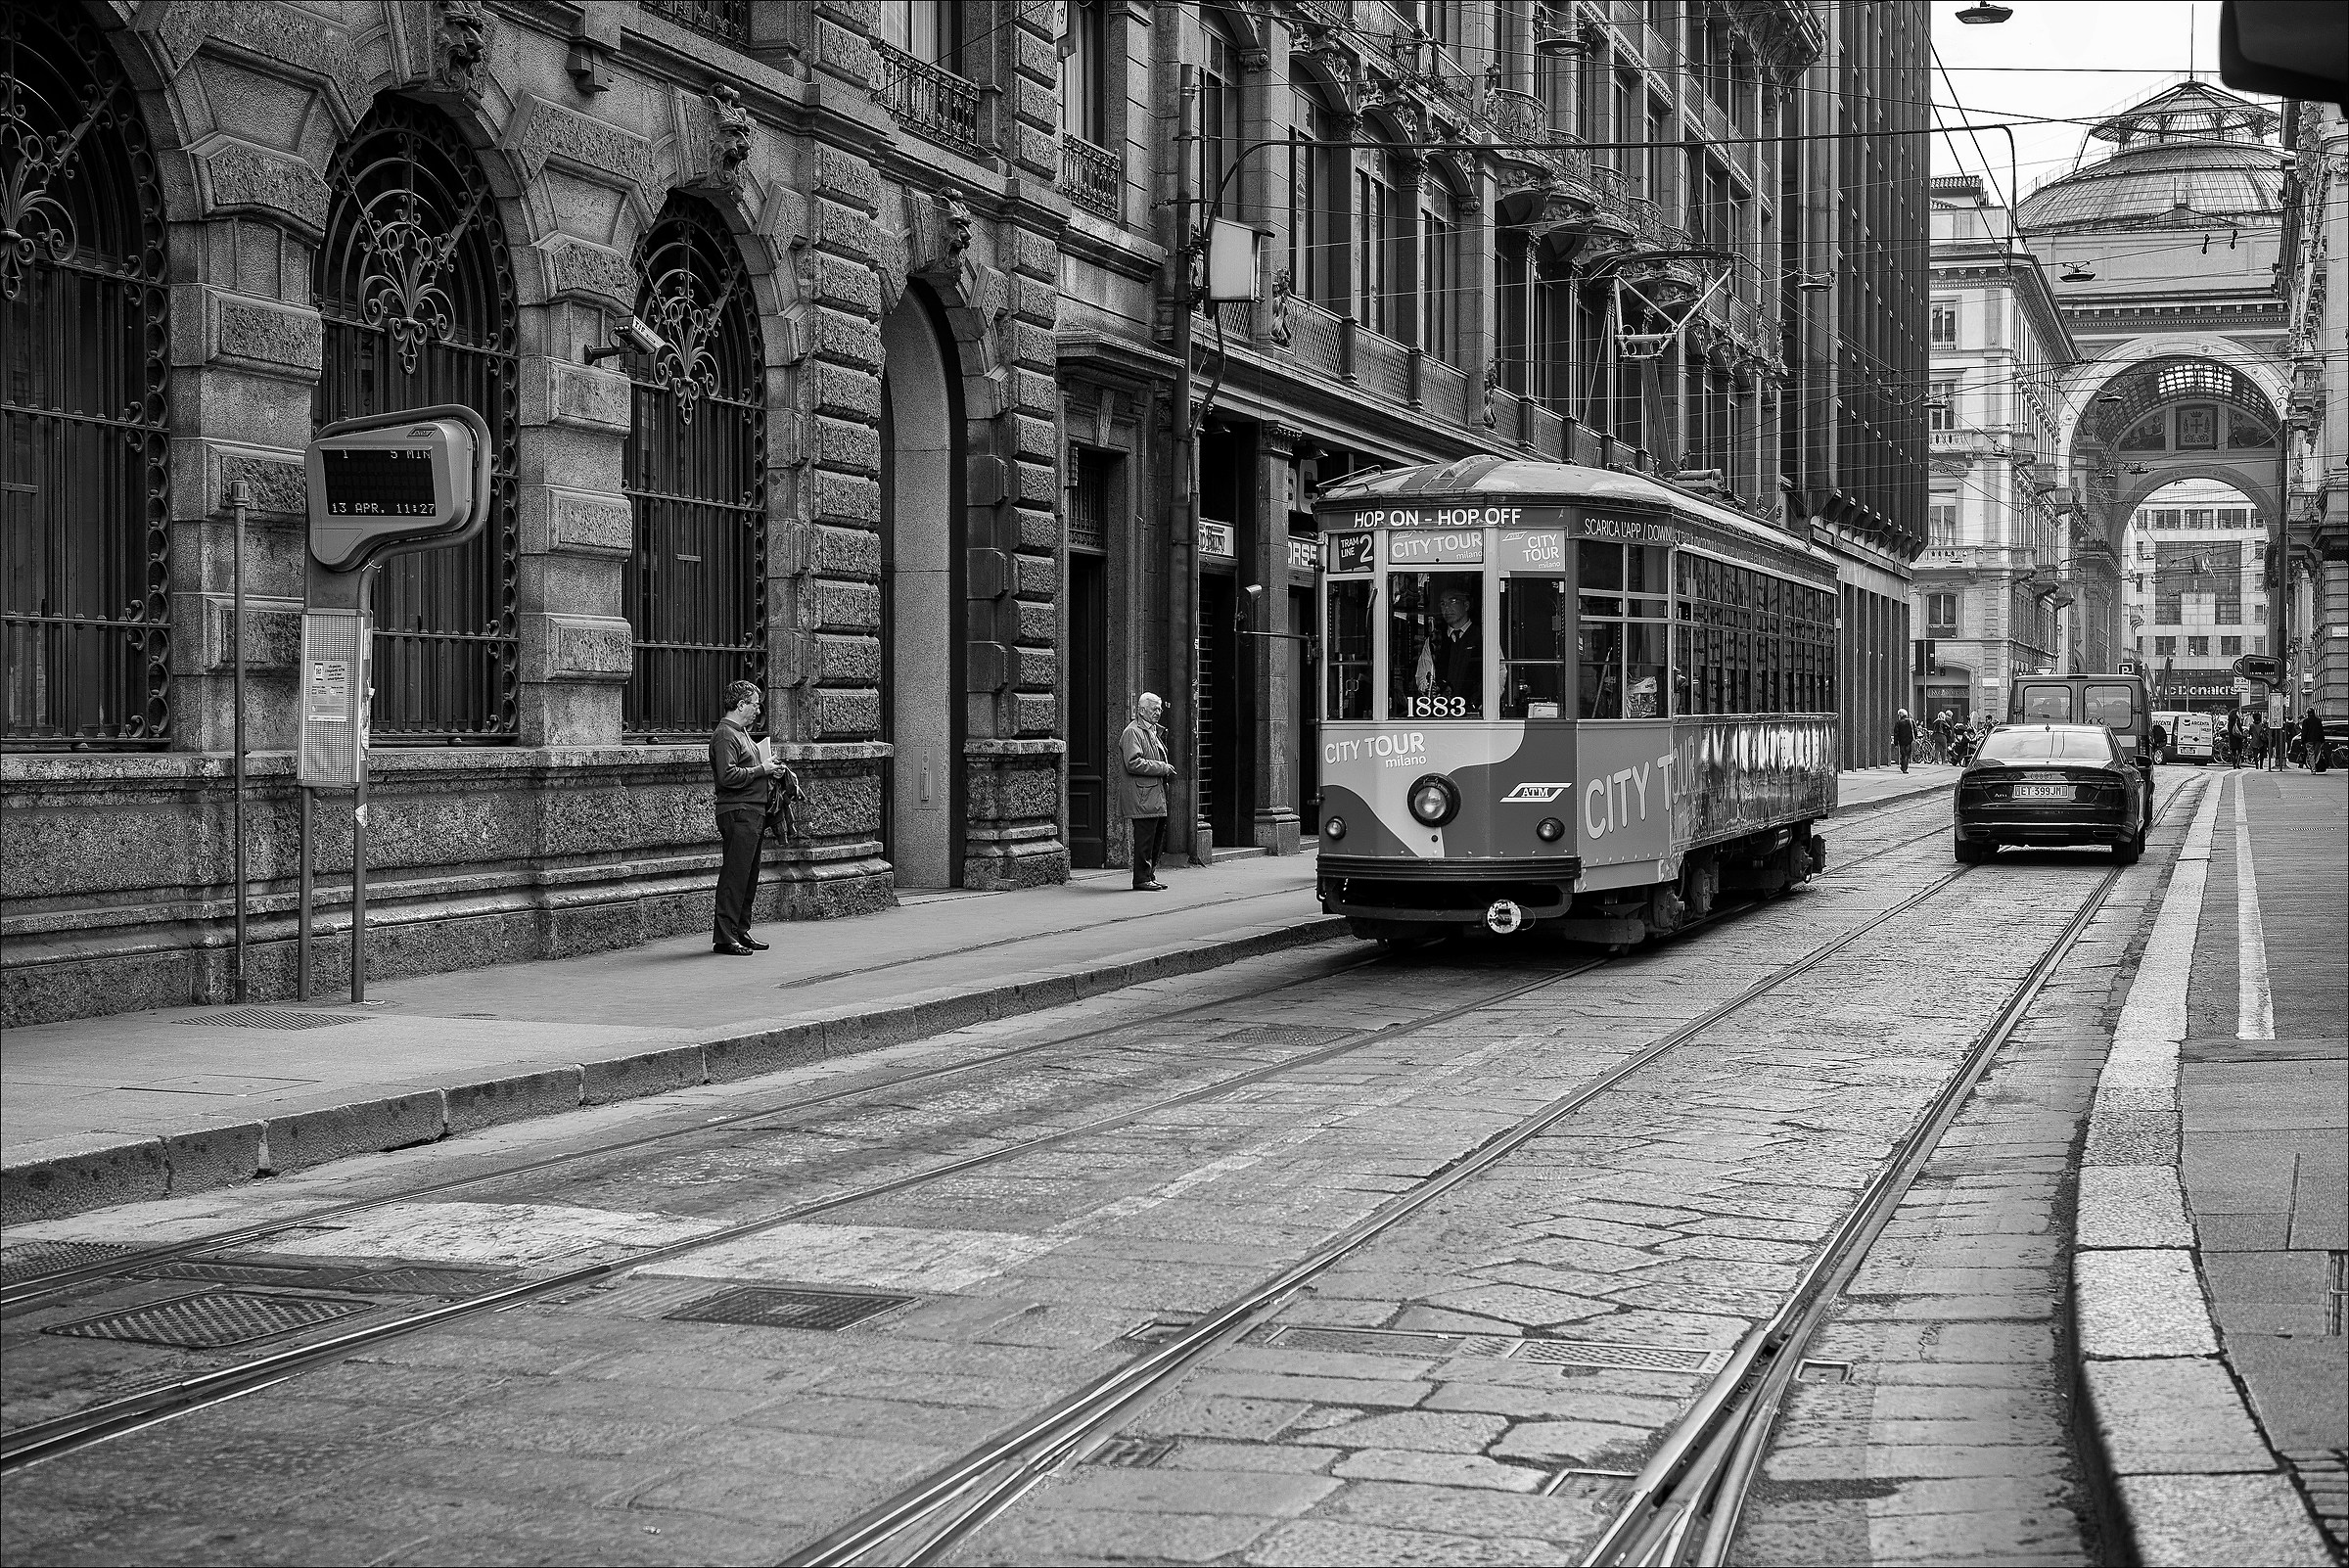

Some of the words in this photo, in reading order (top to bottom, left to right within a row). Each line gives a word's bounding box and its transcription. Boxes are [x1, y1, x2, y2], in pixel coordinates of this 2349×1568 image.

[343, 449, 348, 459] 1
[391, 449, 398, 459] 5
[406, 449, 431, 459] MIN
[333, 502, 346, 513] 13
[354, 502, 385, 514] APR.
[396, 503, 436, 514] 11:27
[1354, 510, 1385, 528] HOP
[1390, 509, 1419, 527] ON
[1438, 508, 1480, 526] HOP
[1485, 507, 1522, 526] OFF
[1585, 518, 1621, 537] SCARICA
[1621, 521, 1641, 538] L'APP
[1340, 536, 1359, 548] TRAM
[1359, 533, 1374, 563] 2
[1391, 537, 1431, 558] CITY
[1433, 531, 1483, 552] TOUR
[1527, 533, 1557, 549] CITY
[1341, 546, 1356, 558] LINE
[1455, 549, 1483, 561] milano
[1522, 546, 1560, 563] TOUR
[1538, 561, 1561, 570] milano
[1406, 696, 1466, 717] 1883
[1324, 739, 1360, 764] CITY
[1364, 732, 1426, 759] TOUR
[1385, 755, 1427, 768] milano
[1520, 787, 1549, 798] ATM
[1585, 761, 1650, 840] CITY
[1657, 735, 1696, 811] TOUR
